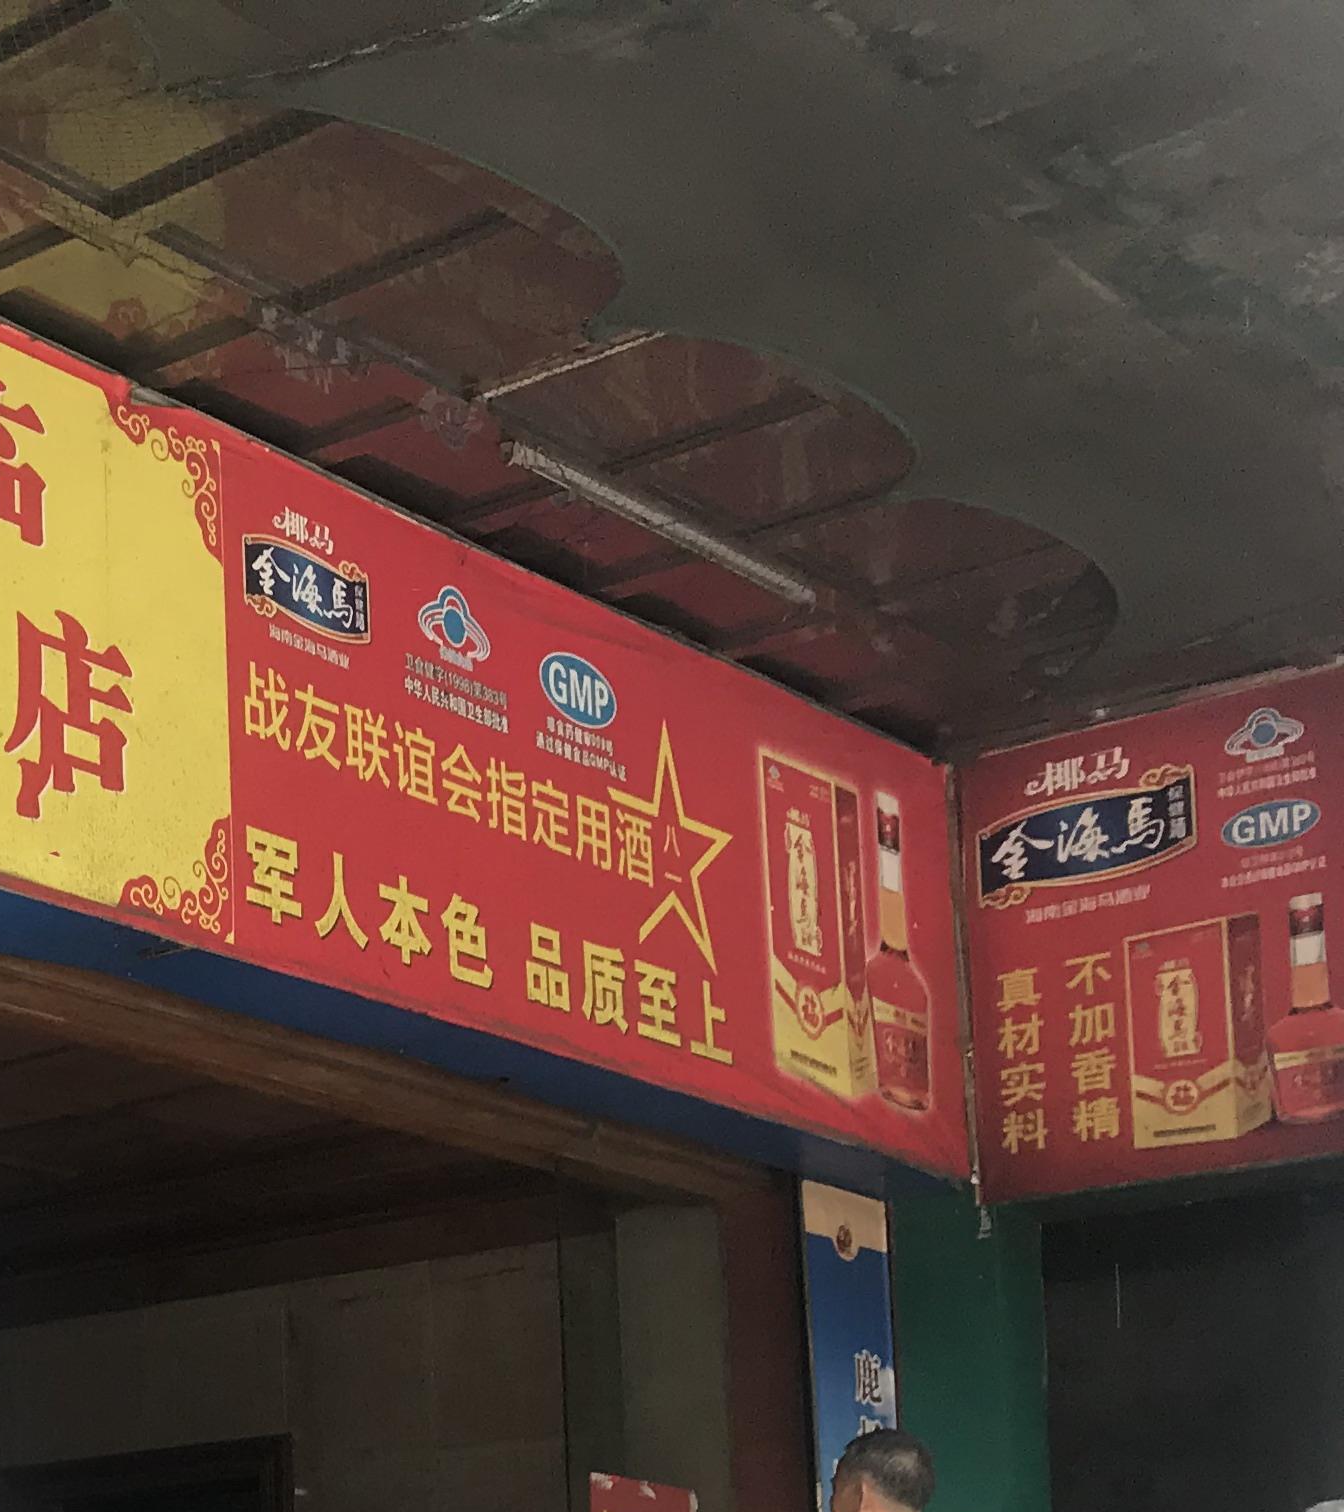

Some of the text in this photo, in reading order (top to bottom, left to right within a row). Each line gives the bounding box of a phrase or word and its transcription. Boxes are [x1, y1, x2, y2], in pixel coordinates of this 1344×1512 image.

[272, 506, 334, 555] 椰马
[548, 660, 609, 720] GMP
[243, 661, 655, 889] 战友联谊会指定用酒
[1024, 746, 1131, 798] 椰马
[1231, 803, 1312, 844] GMP
[244, 825, 734, 1067] 军人本色 品质至上
[996, 967, 1048, 1155] 真材实料
[1065, 951, 1120, 1143] 不加香精
